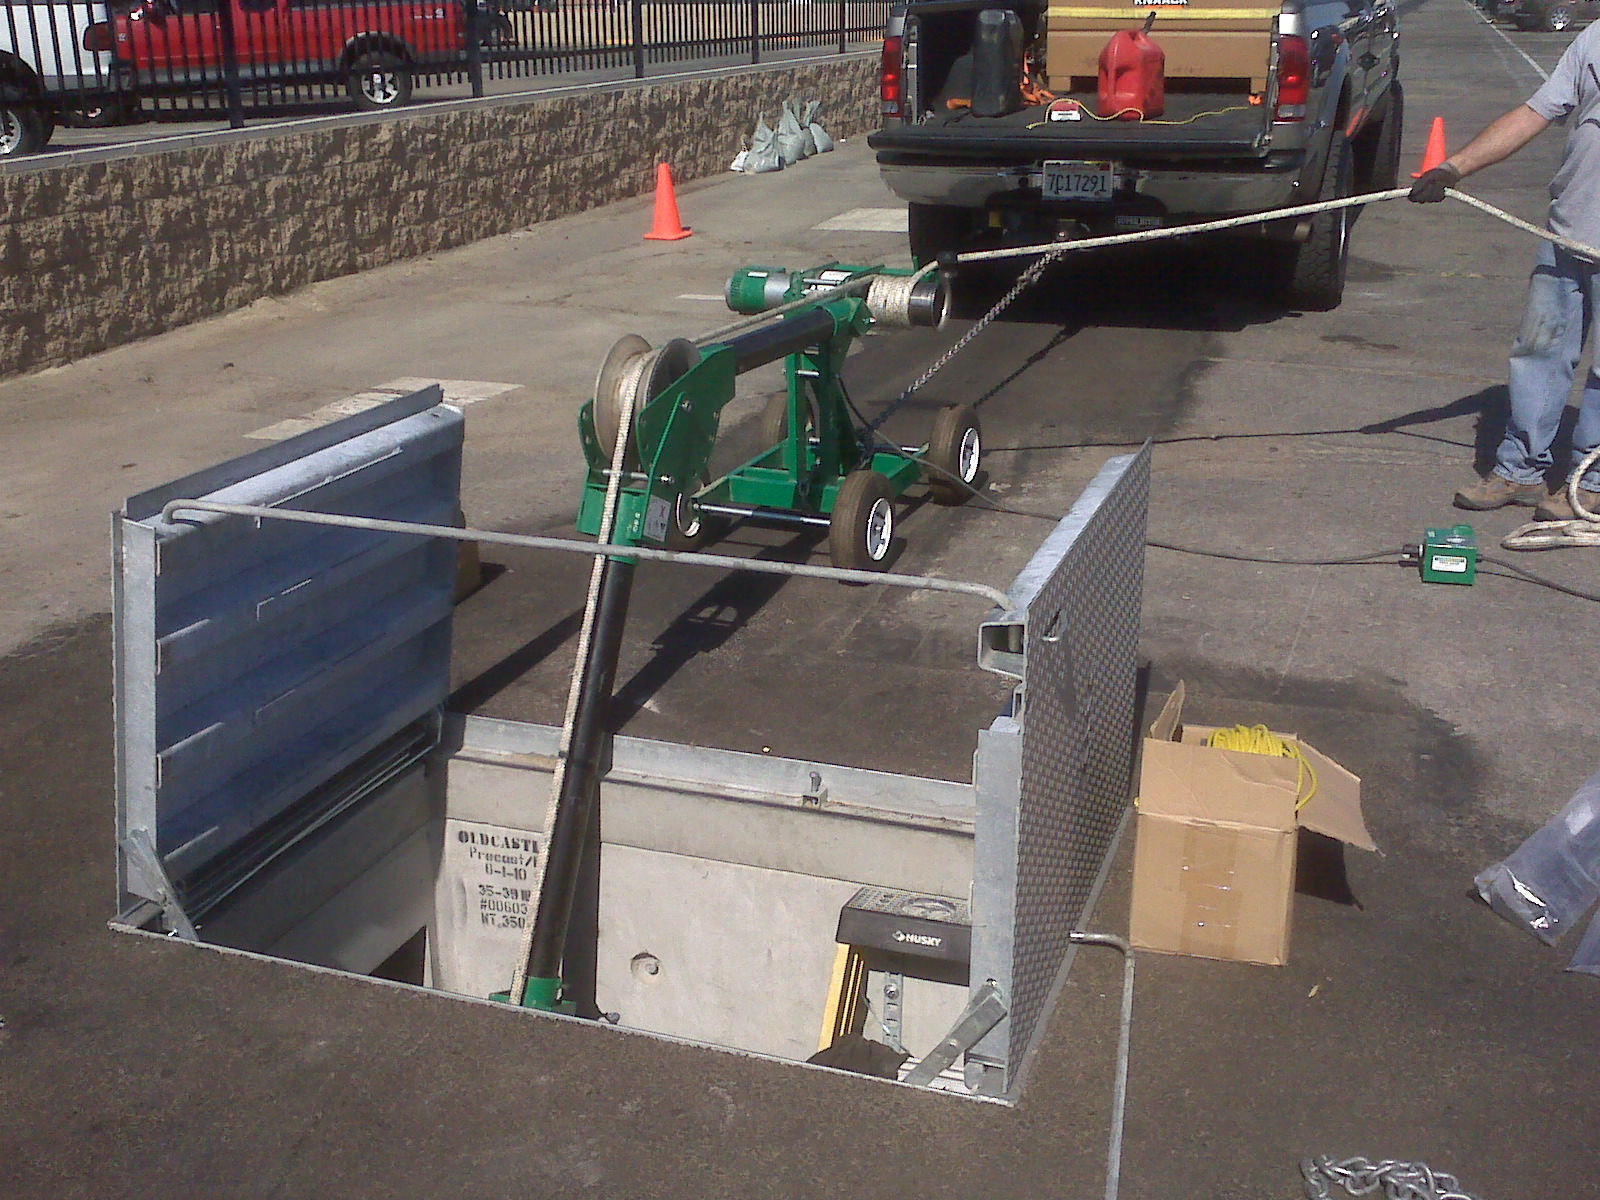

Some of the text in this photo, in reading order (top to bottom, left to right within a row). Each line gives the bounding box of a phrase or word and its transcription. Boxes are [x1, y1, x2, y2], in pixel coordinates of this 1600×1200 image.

[1047, 174, 1107, 193] 7C17291
[458, 830, 540, 854] OLDCASTL
[469, 846, 538, 868] Precast/
[905, 933, 942, 947] HUSKY
